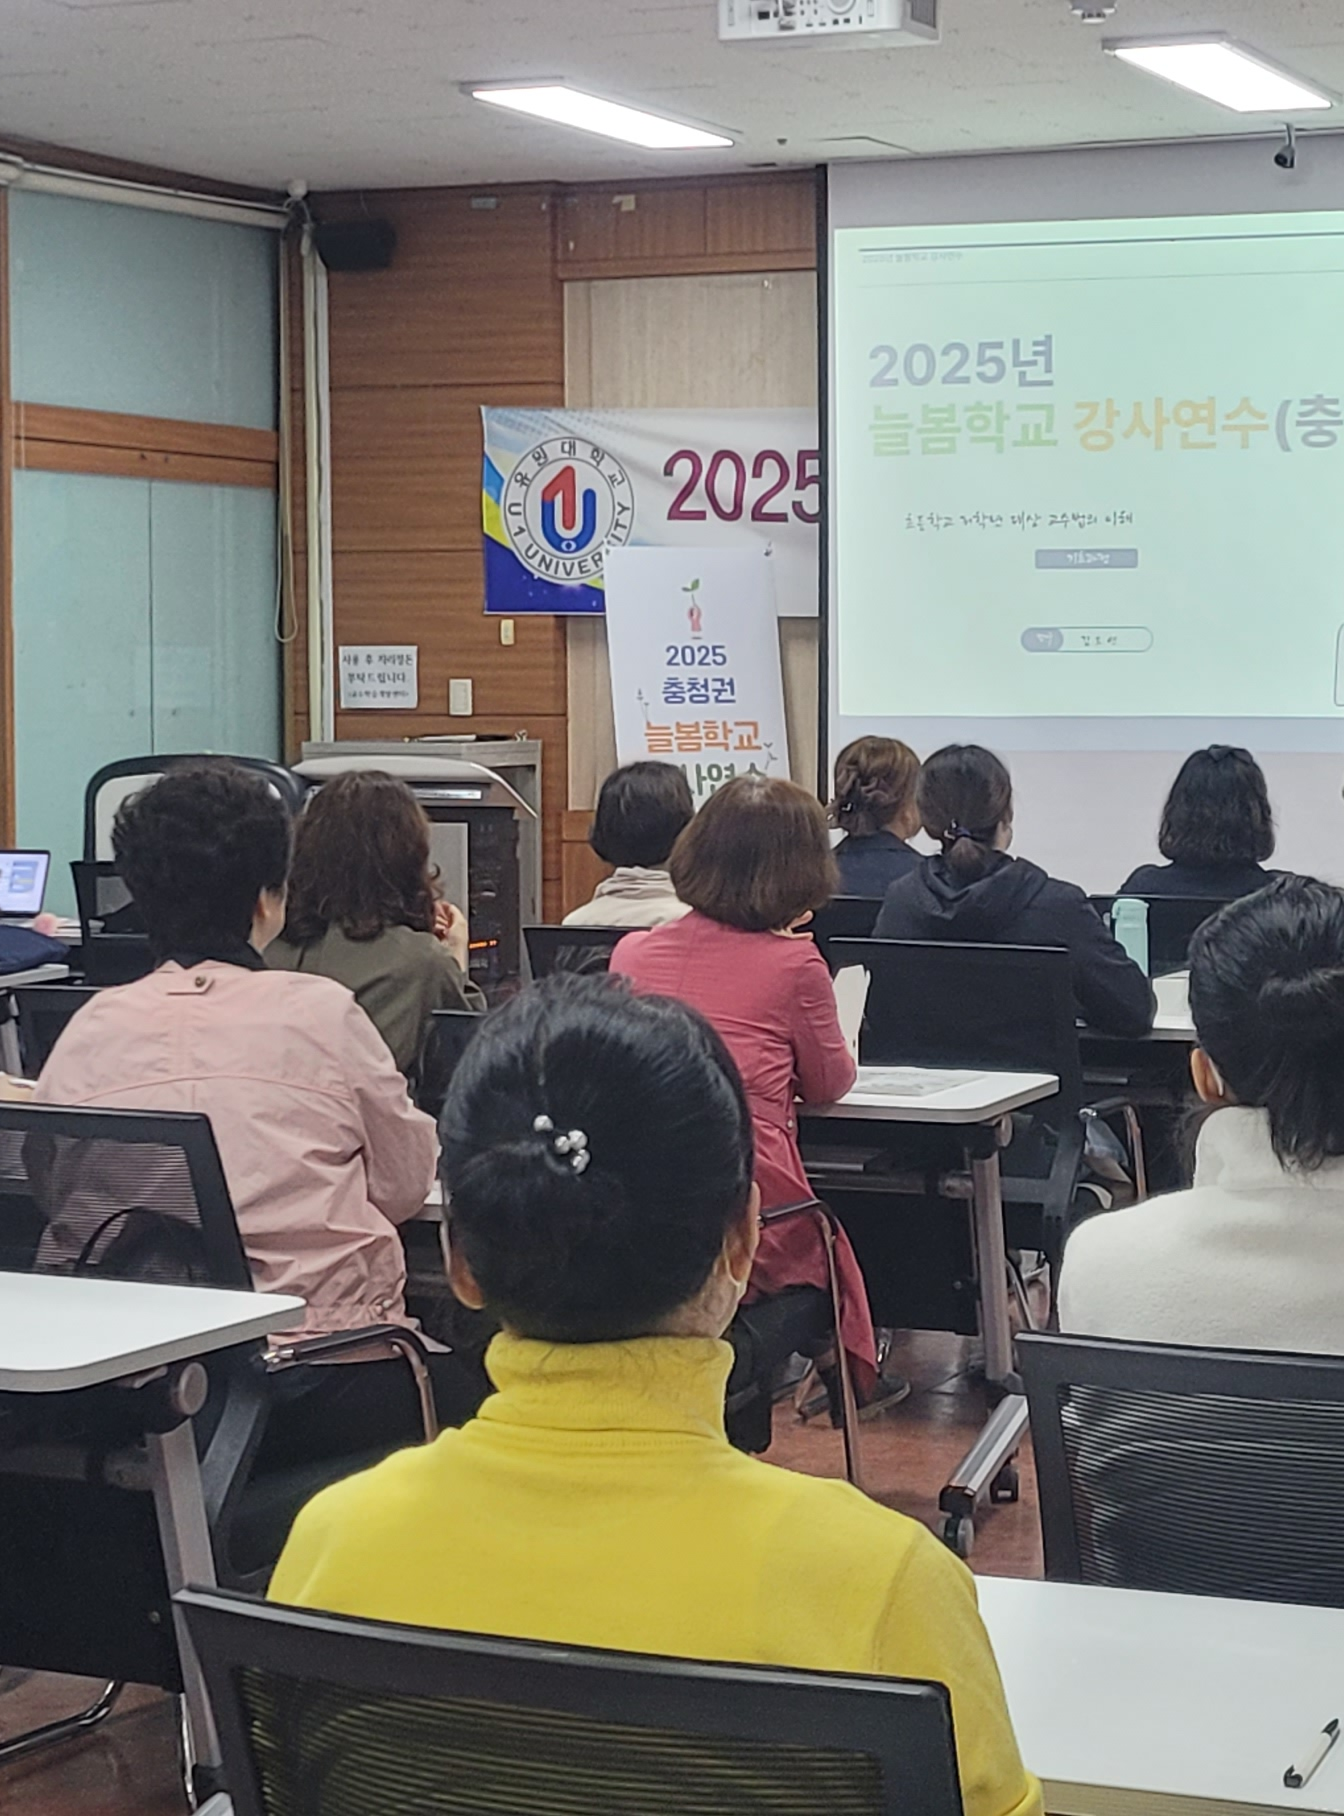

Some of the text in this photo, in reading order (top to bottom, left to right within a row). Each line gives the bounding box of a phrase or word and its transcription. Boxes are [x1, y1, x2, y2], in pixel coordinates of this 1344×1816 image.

[868, 334, 1056, 389] 2025년
[867, 401, 1058, 457] 늘봄학교
[663, 449, 820, 523] 2025
[1011, 510, 1042, 530] 대상
[1104, 509, 1134, 526] 이해
[665, 645, 727, 667] 2025
[661, 678, 737, 705] 충청권
[644, 721, 763, 753] 늘봄학교
